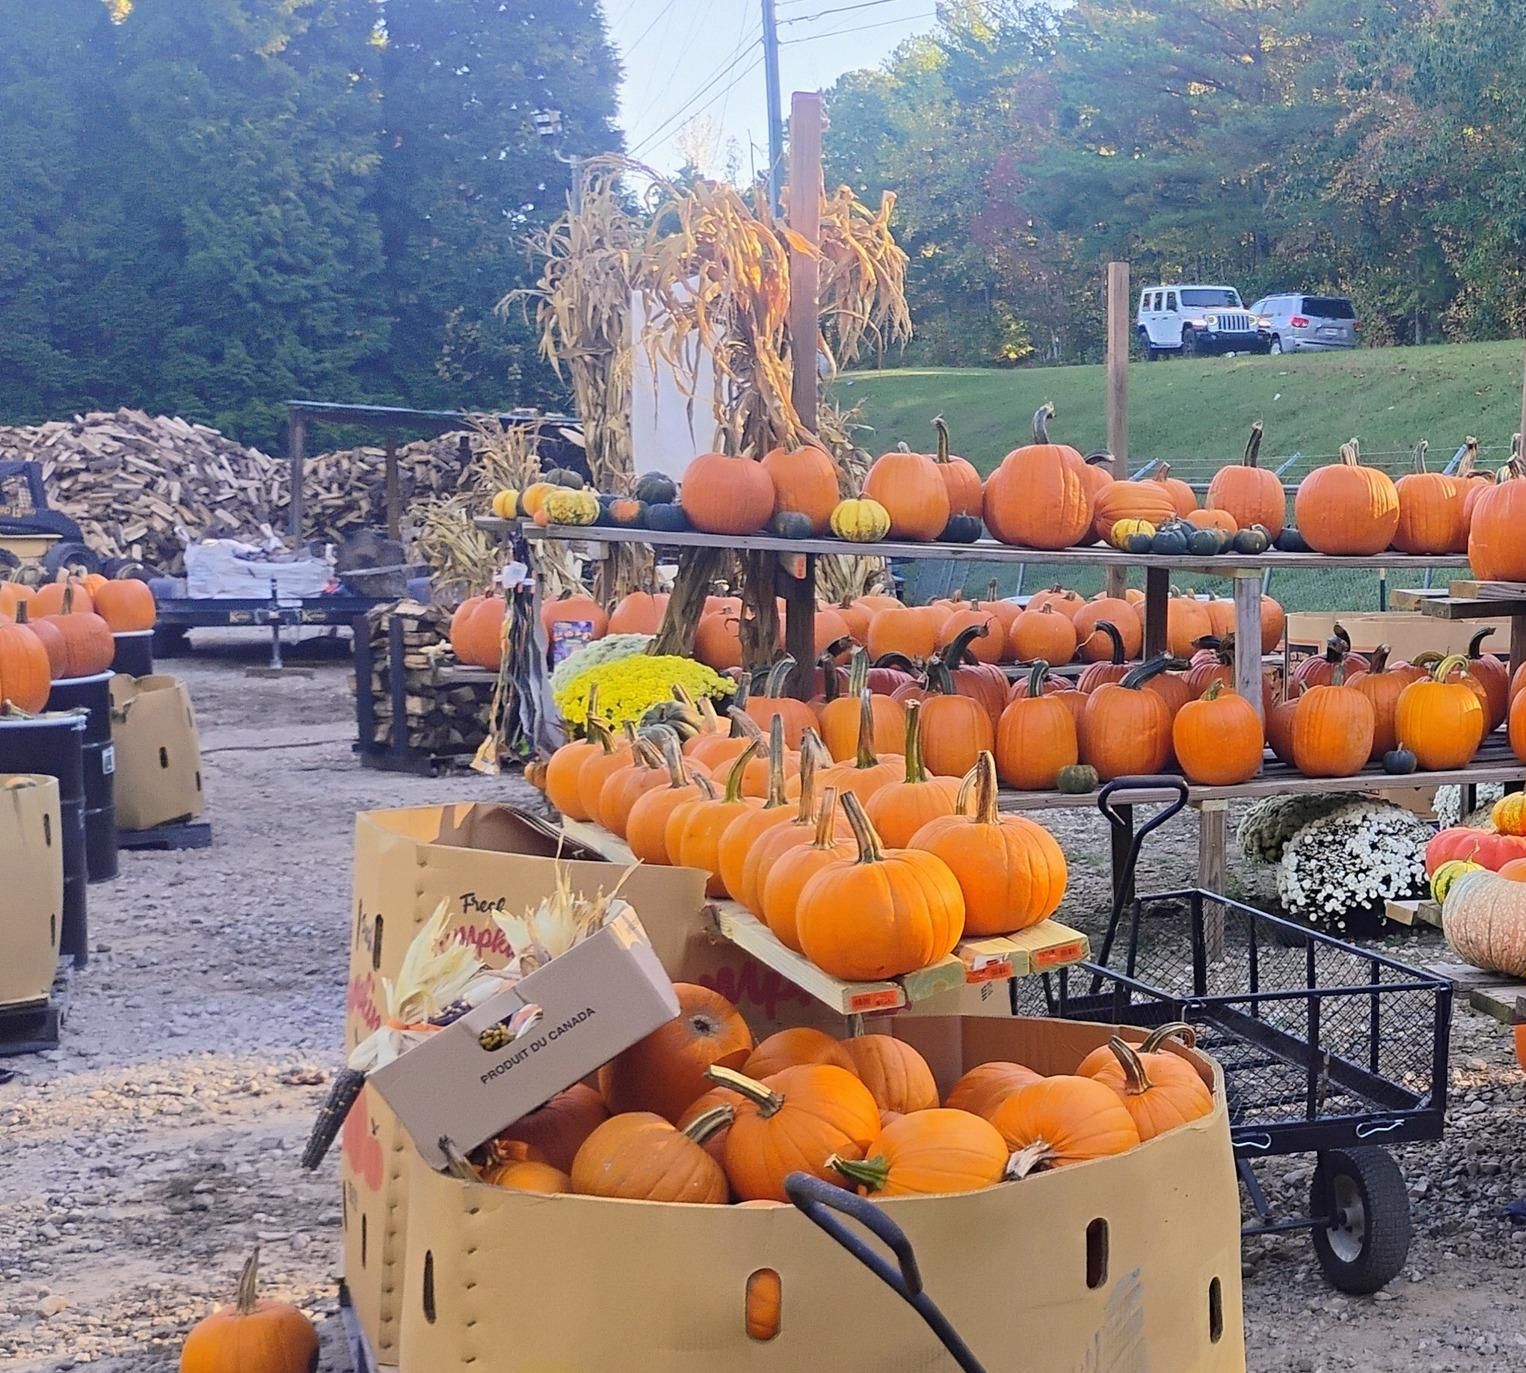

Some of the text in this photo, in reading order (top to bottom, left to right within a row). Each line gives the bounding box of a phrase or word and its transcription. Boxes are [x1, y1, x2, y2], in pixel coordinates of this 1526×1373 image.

[480, 1007, 596, 1085] PRODUIT DU CANADA
